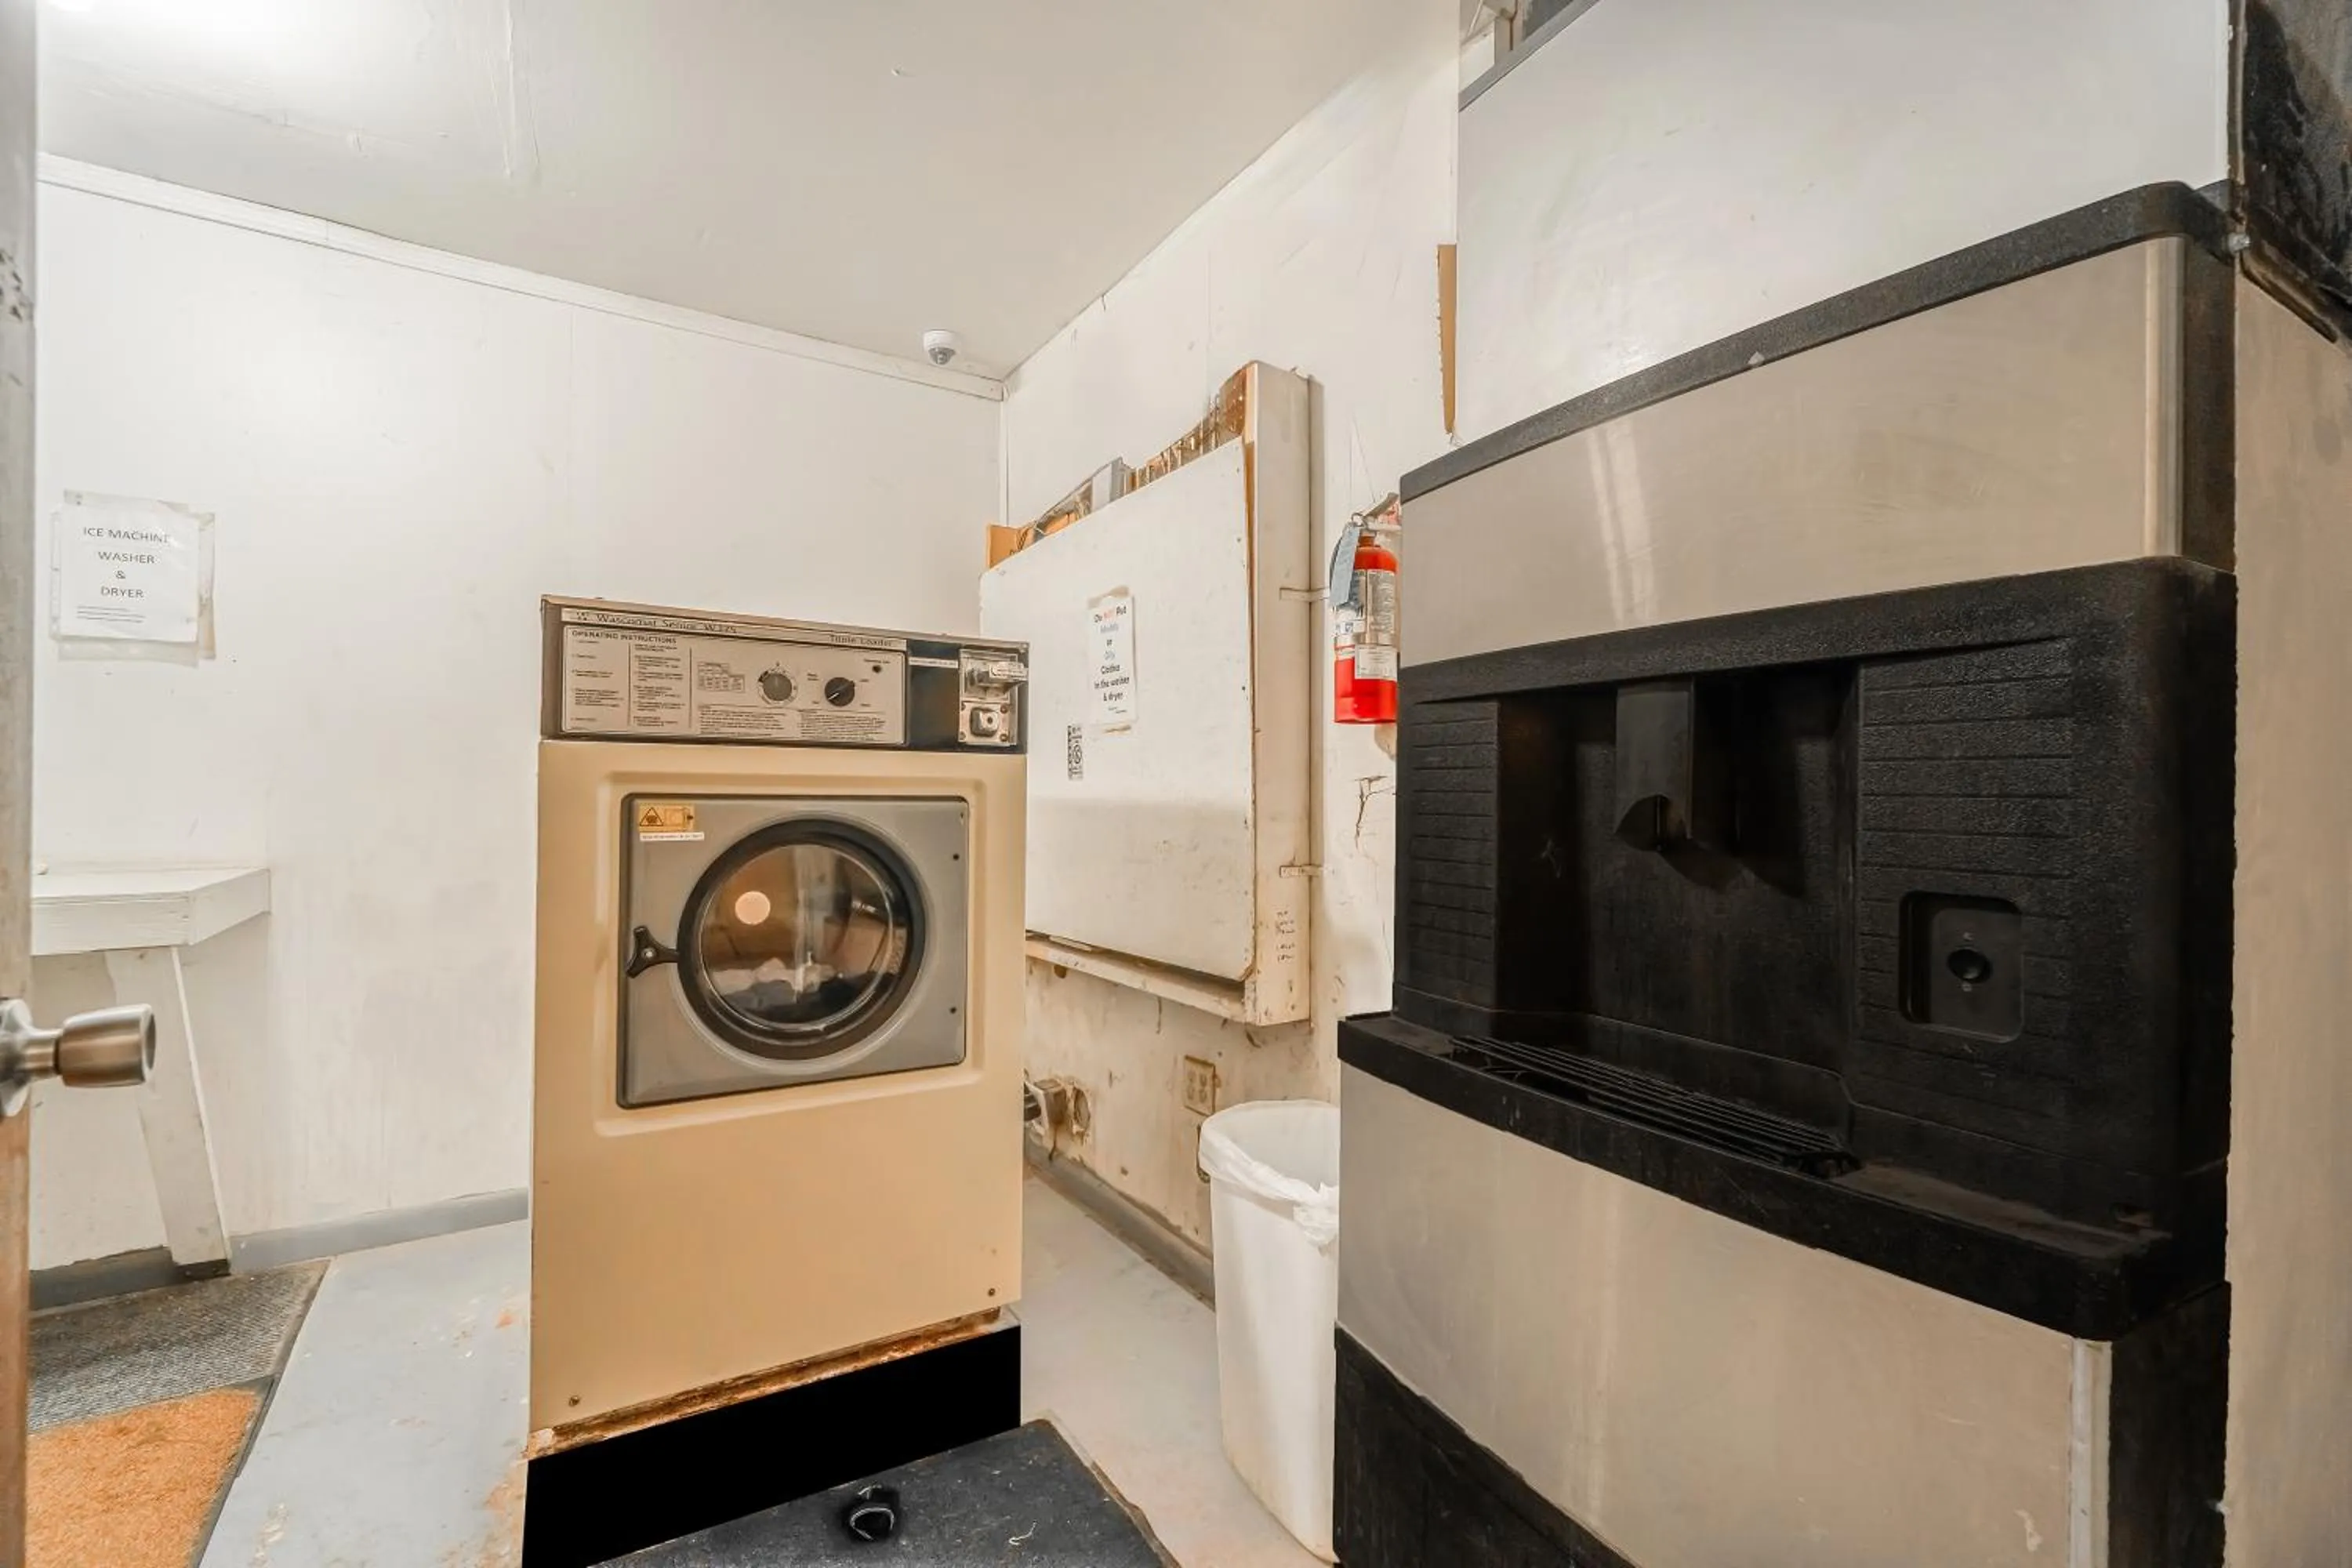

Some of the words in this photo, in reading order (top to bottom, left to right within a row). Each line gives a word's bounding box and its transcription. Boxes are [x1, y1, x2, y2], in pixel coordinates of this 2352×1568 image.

[83, 527, 103, 537] ICE
[98, 551, 155, 564] WASHER
[115, 570, 125, 579] &
[100, 586, 144, 598] DRYER
[572, 630, 619, 640] OPERATING
[620, 634, 677, 644] INSTRUCTIONS
